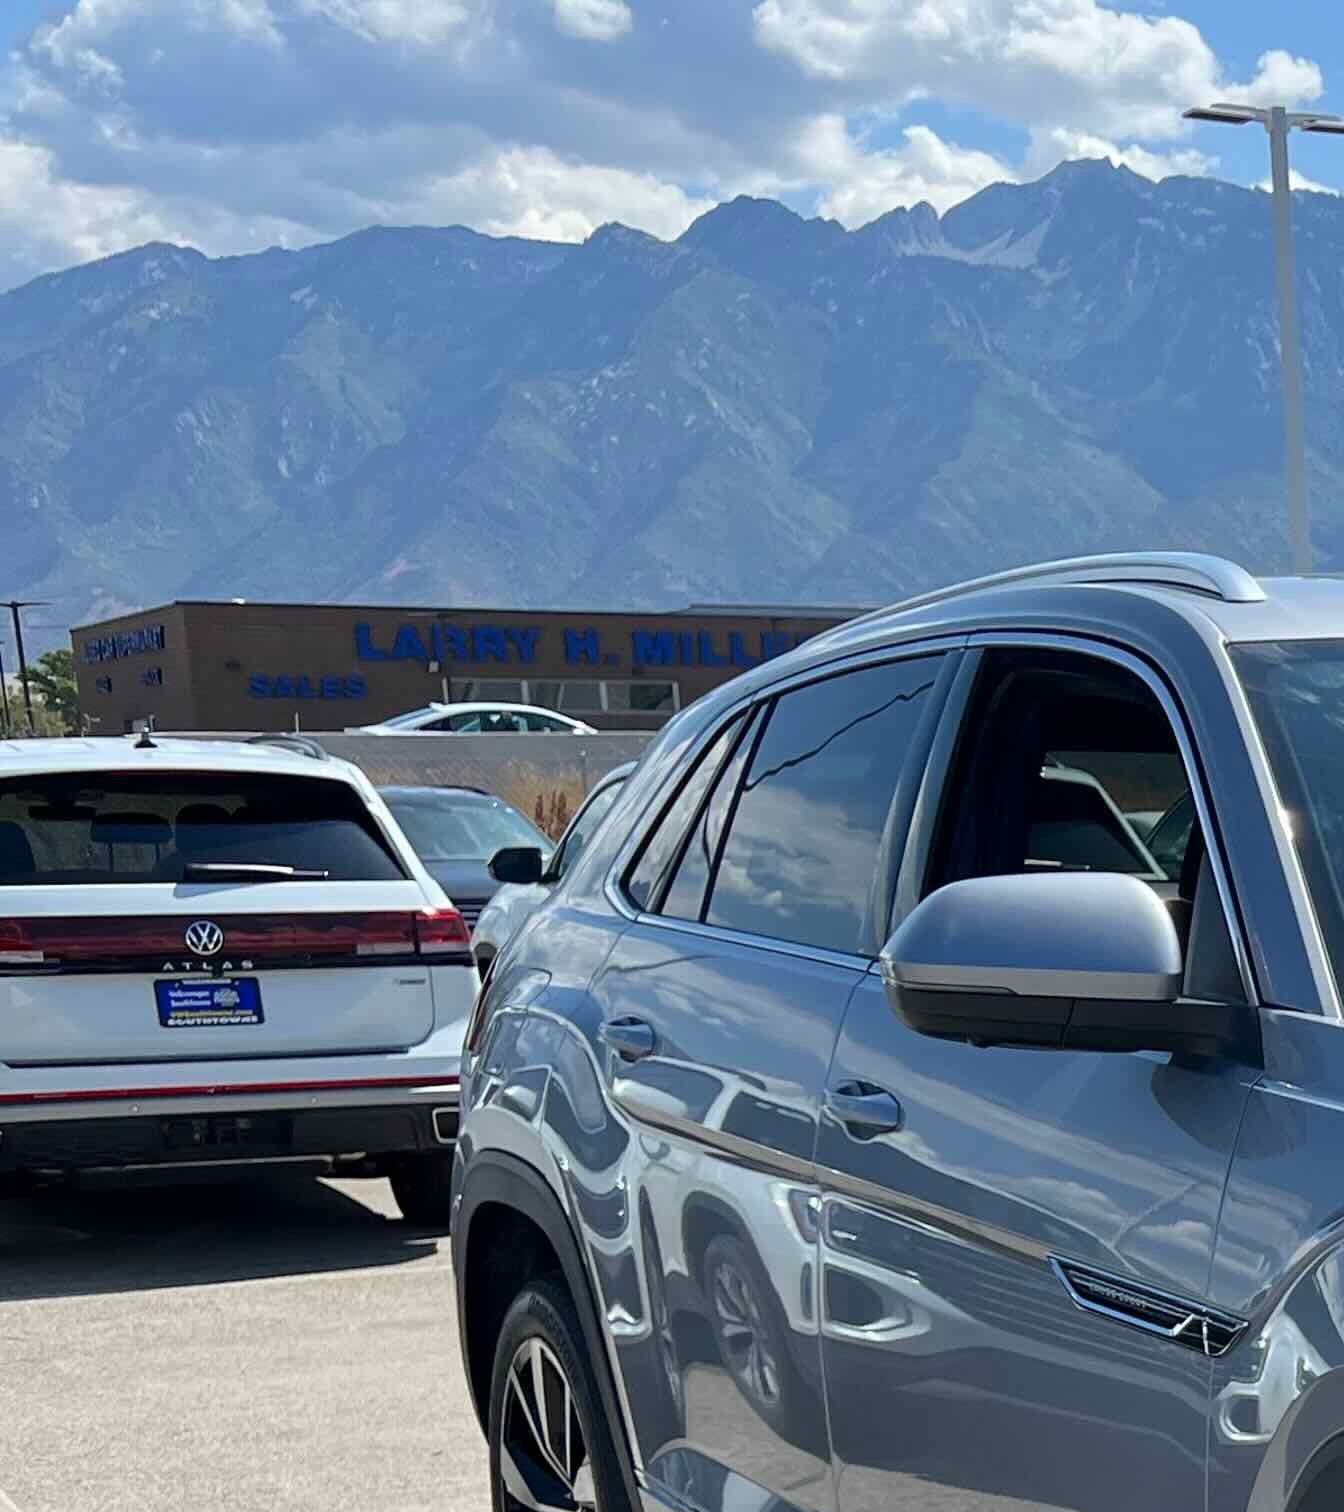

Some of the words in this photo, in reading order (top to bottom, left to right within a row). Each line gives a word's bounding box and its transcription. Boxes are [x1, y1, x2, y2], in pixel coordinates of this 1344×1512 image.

[356, 623, 543, 664] LARRY
[564, 626, 619, 666] H.
[631, 629, 806, 668] MILLE
[249, 672, 368, 701] SALES
[163, 959, 254, 971] ATLAS
